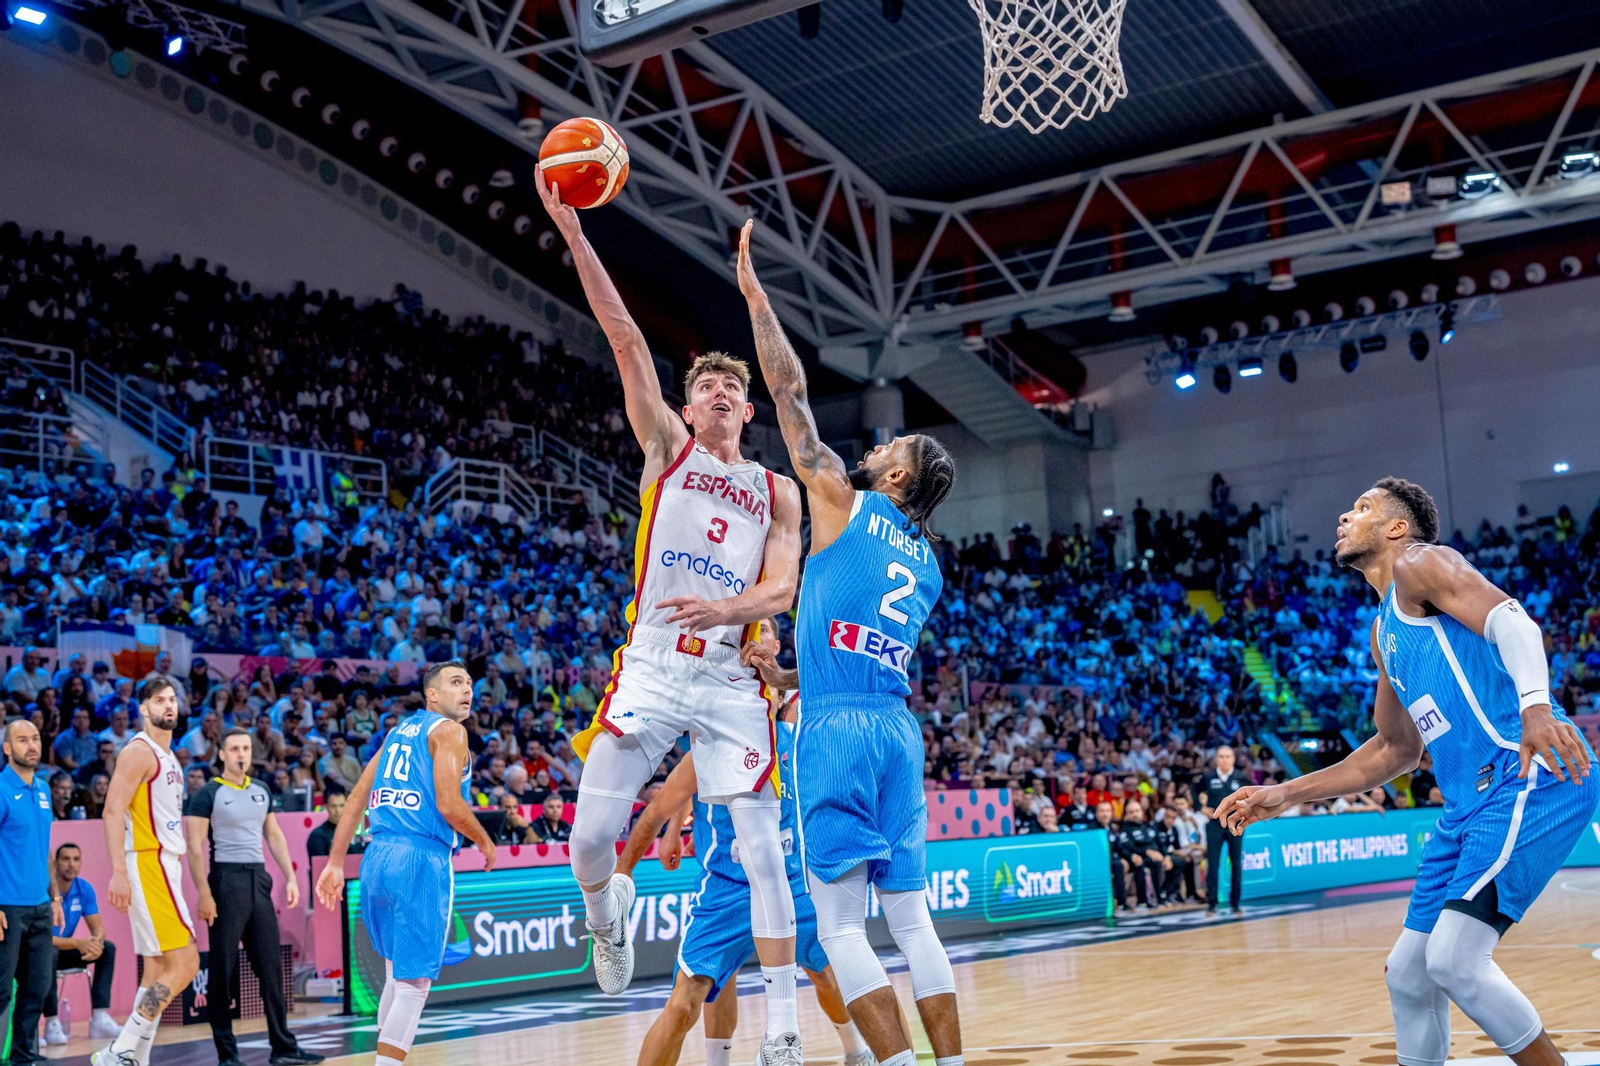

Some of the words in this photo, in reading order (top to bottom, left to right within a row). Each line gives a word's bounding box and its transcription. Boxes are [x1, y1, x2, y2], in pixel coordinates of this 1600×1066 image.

[707, 517, 729, 544] 3
[867, 512, 929, 565] NTORSEY
[661, 550, 746, 596] endesa
[878, 561, 917, 626] 2
[383, 742, 412, 782] 10
[380, 789, 420, 808] EKO
[1281, 840, 1313, 868] VISIT
[1314, 839, 1339, 864] THE
[1340, 833, 1409, 862] PHILIPPINES
[1016, 860, 1073, 899] Smart
[474, 904, 577, 957] Smart
[627, 892, 697, 943] VISI
